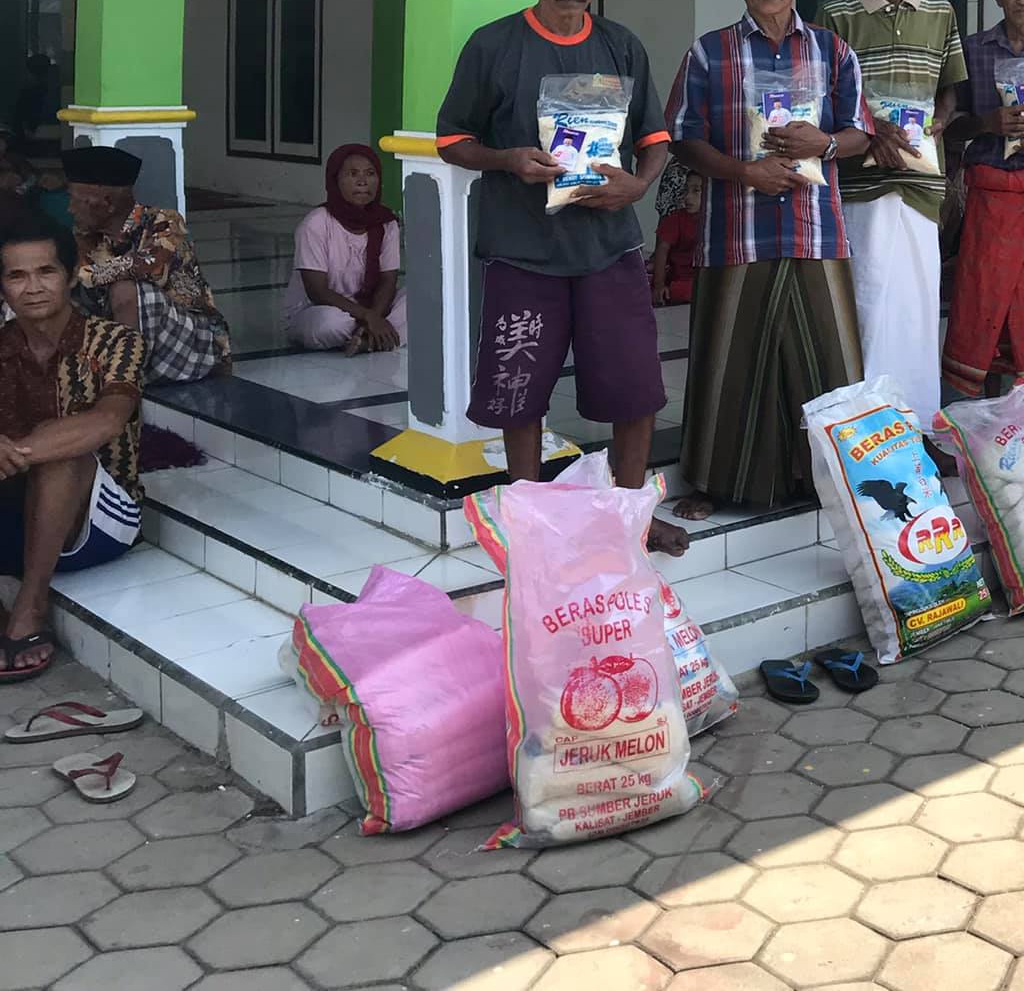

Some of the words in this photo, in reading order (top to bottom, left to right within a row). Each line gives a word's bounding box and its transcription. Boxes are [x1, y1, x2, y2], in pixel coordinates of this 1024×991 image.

[850, 421, 905, 462] BERAS
[542, 594, 605, 634] BERAS
[607, 591, 652, 614] POLES
[909, 617, 926, 629] CV.
[927, 599, 965, 623] RAJAWALI
[581, 619, 632, 646] SUPER
[671, 624, 703, 649] MELON
[691, 660, 701, 673] 25
[682, 680, 702, 700] MBER
[555, 736, 578, 744] CAP
[559, 743, 613, 767] JERUK
[615, 731, 665, 759] MELON
[576, 777, 617, 796] BERAT
[620, 775, 635, 789] 25
[637, 772, 652, 786] kg
[633, 787, 673, 809] JERUK
[575, 816, 614, 832] KALISAT
[622, 804, 660, 823] JEMBER
